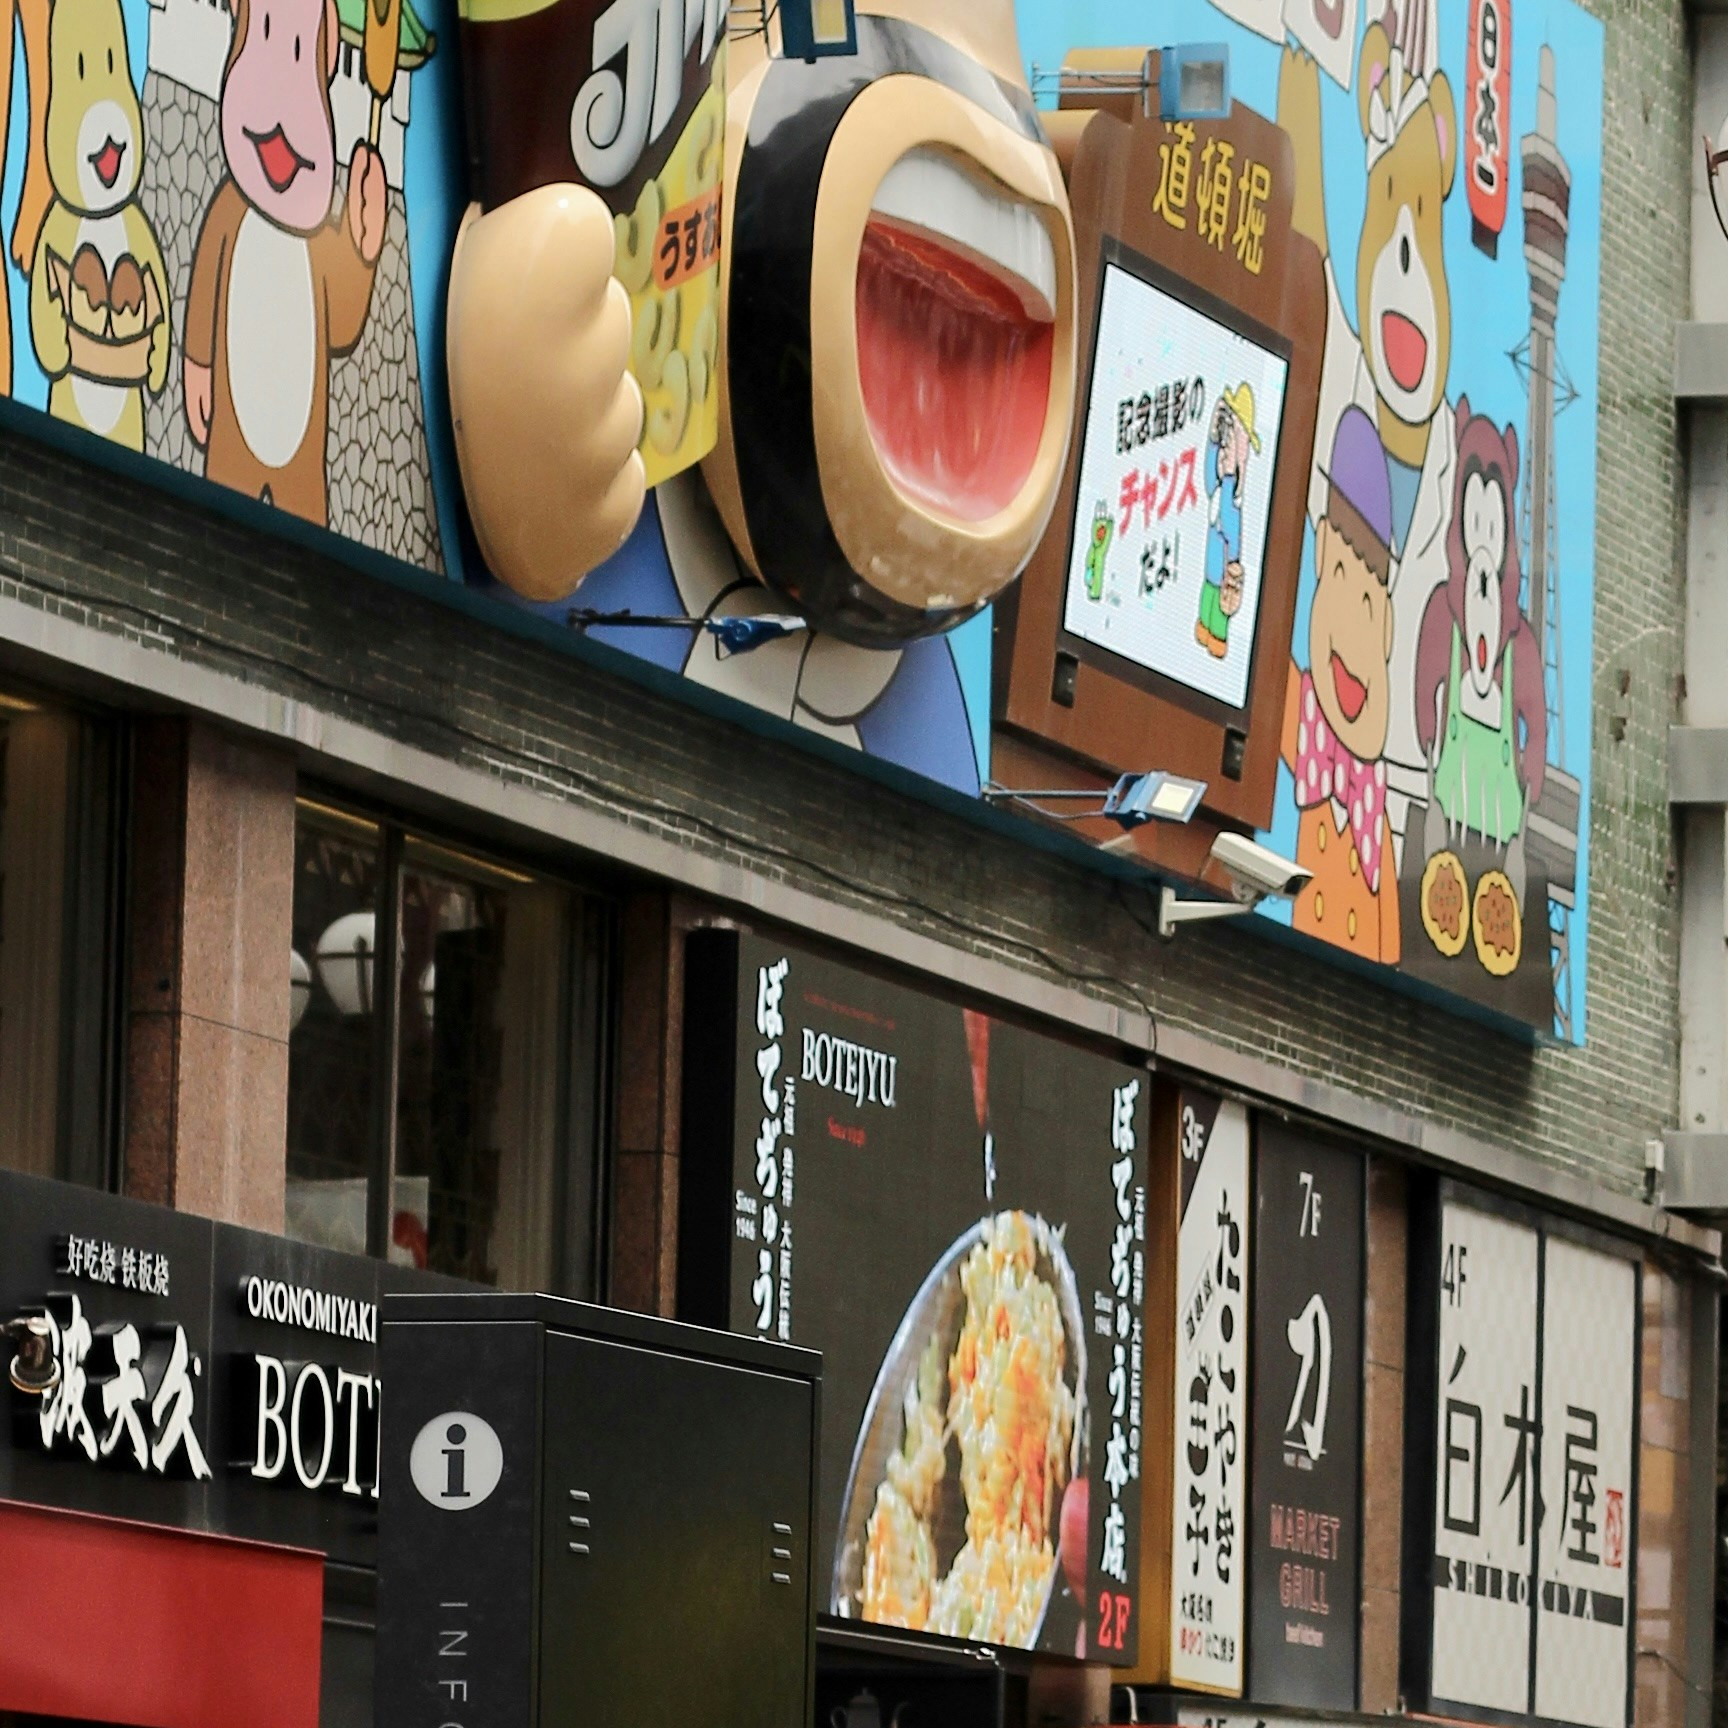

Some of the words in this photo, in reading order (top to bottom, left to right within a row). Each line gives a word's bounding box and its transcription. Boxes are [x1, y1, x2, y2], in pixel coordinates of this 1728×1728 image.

[1152, 120, 1270, 275] 道頓堀
[1116, 377, 1205, 454] 記念撮影の
[1118, 448, 1199, 537] チャンス
[801, 1028, 896, 1108] BOTEJYU
[1182, 1105, 1203, 1163] 3F
[1299, 1172, 1322, 1237] 7F
[67, 1234, 116, 1285] 好吃烧
[121, 1251, 170, 1296] 铁板烧
[1443, 1244, 1467, 1308] 4F
[247, 1275, 377, 1344] OKONOMIYAKI
[252, 1355, 382, 1498] BOT
[1443, 1343, 1600, 1568] 白木屋
[1270, 1503, 1340, 1560] MARKET
[1100, 1591, 1130, 1651] 2F
[1279, 1562, 1329, 1615] GRILL
